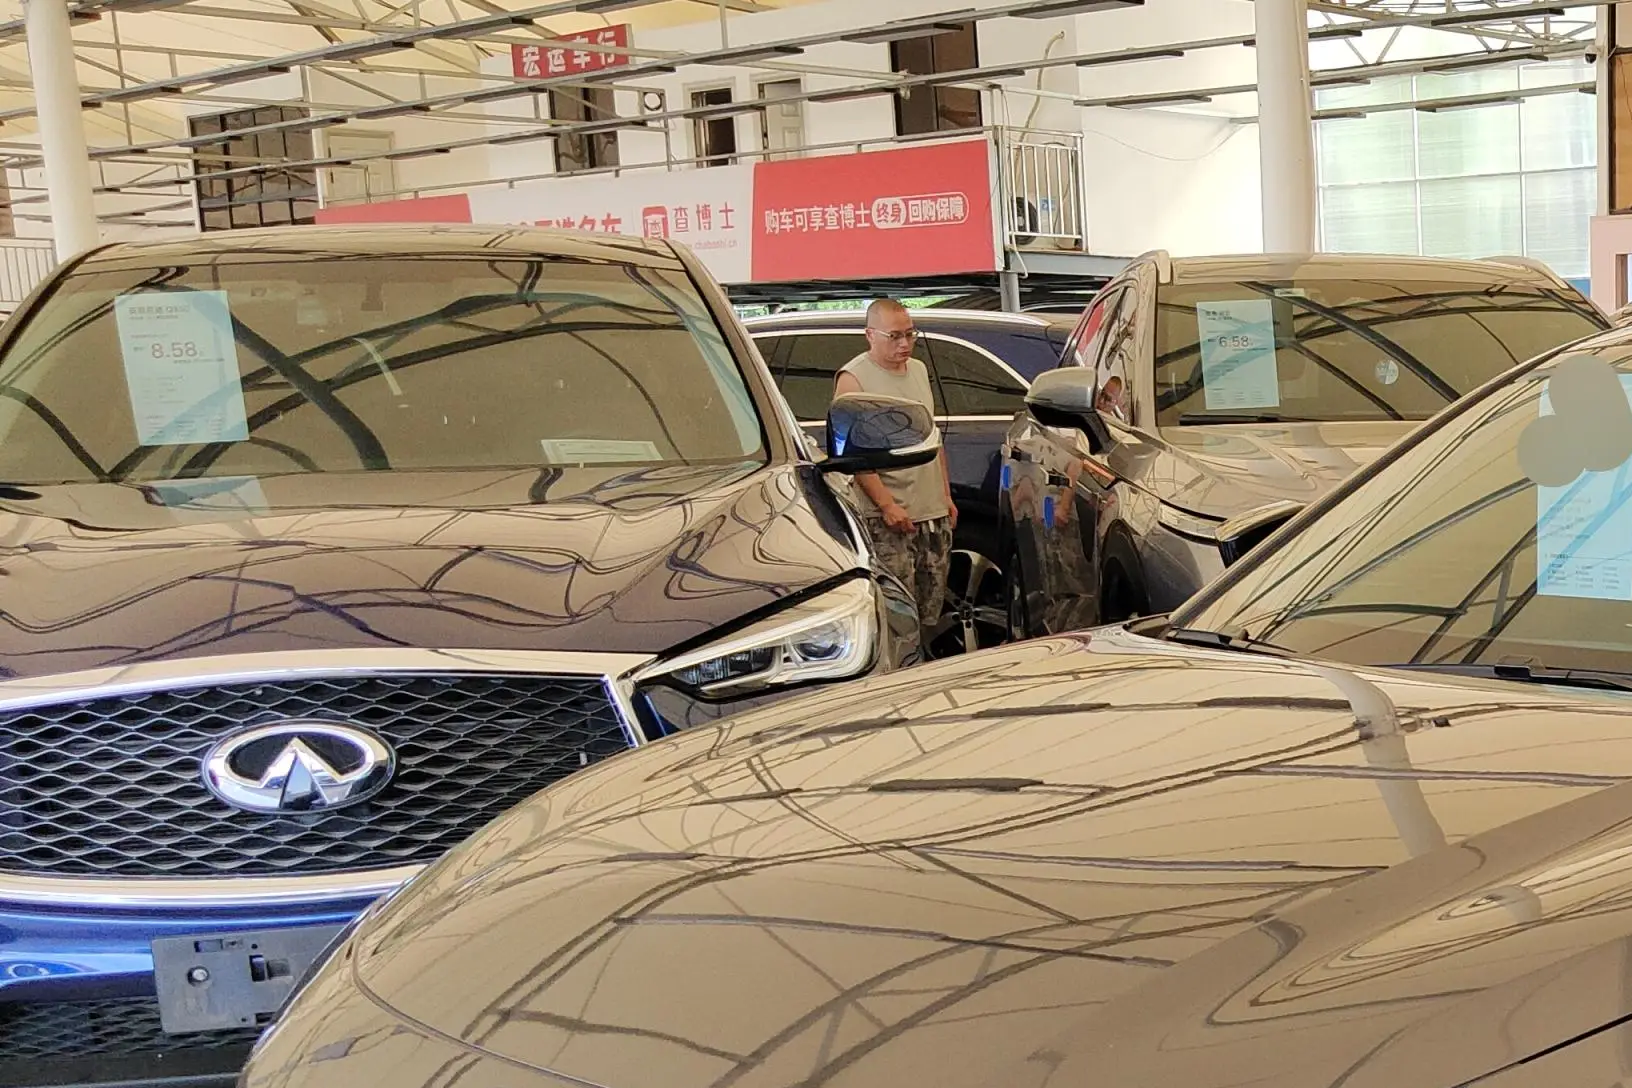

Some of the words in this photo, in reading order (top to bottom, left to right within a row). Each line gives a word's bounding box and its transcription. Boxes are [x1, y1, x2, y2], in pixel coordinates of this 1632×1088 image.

[522, 31, 617, 77] 宏运车行
[673, 201, 735, 232] 查博士
[152, 341, 198, 359] 8.58
